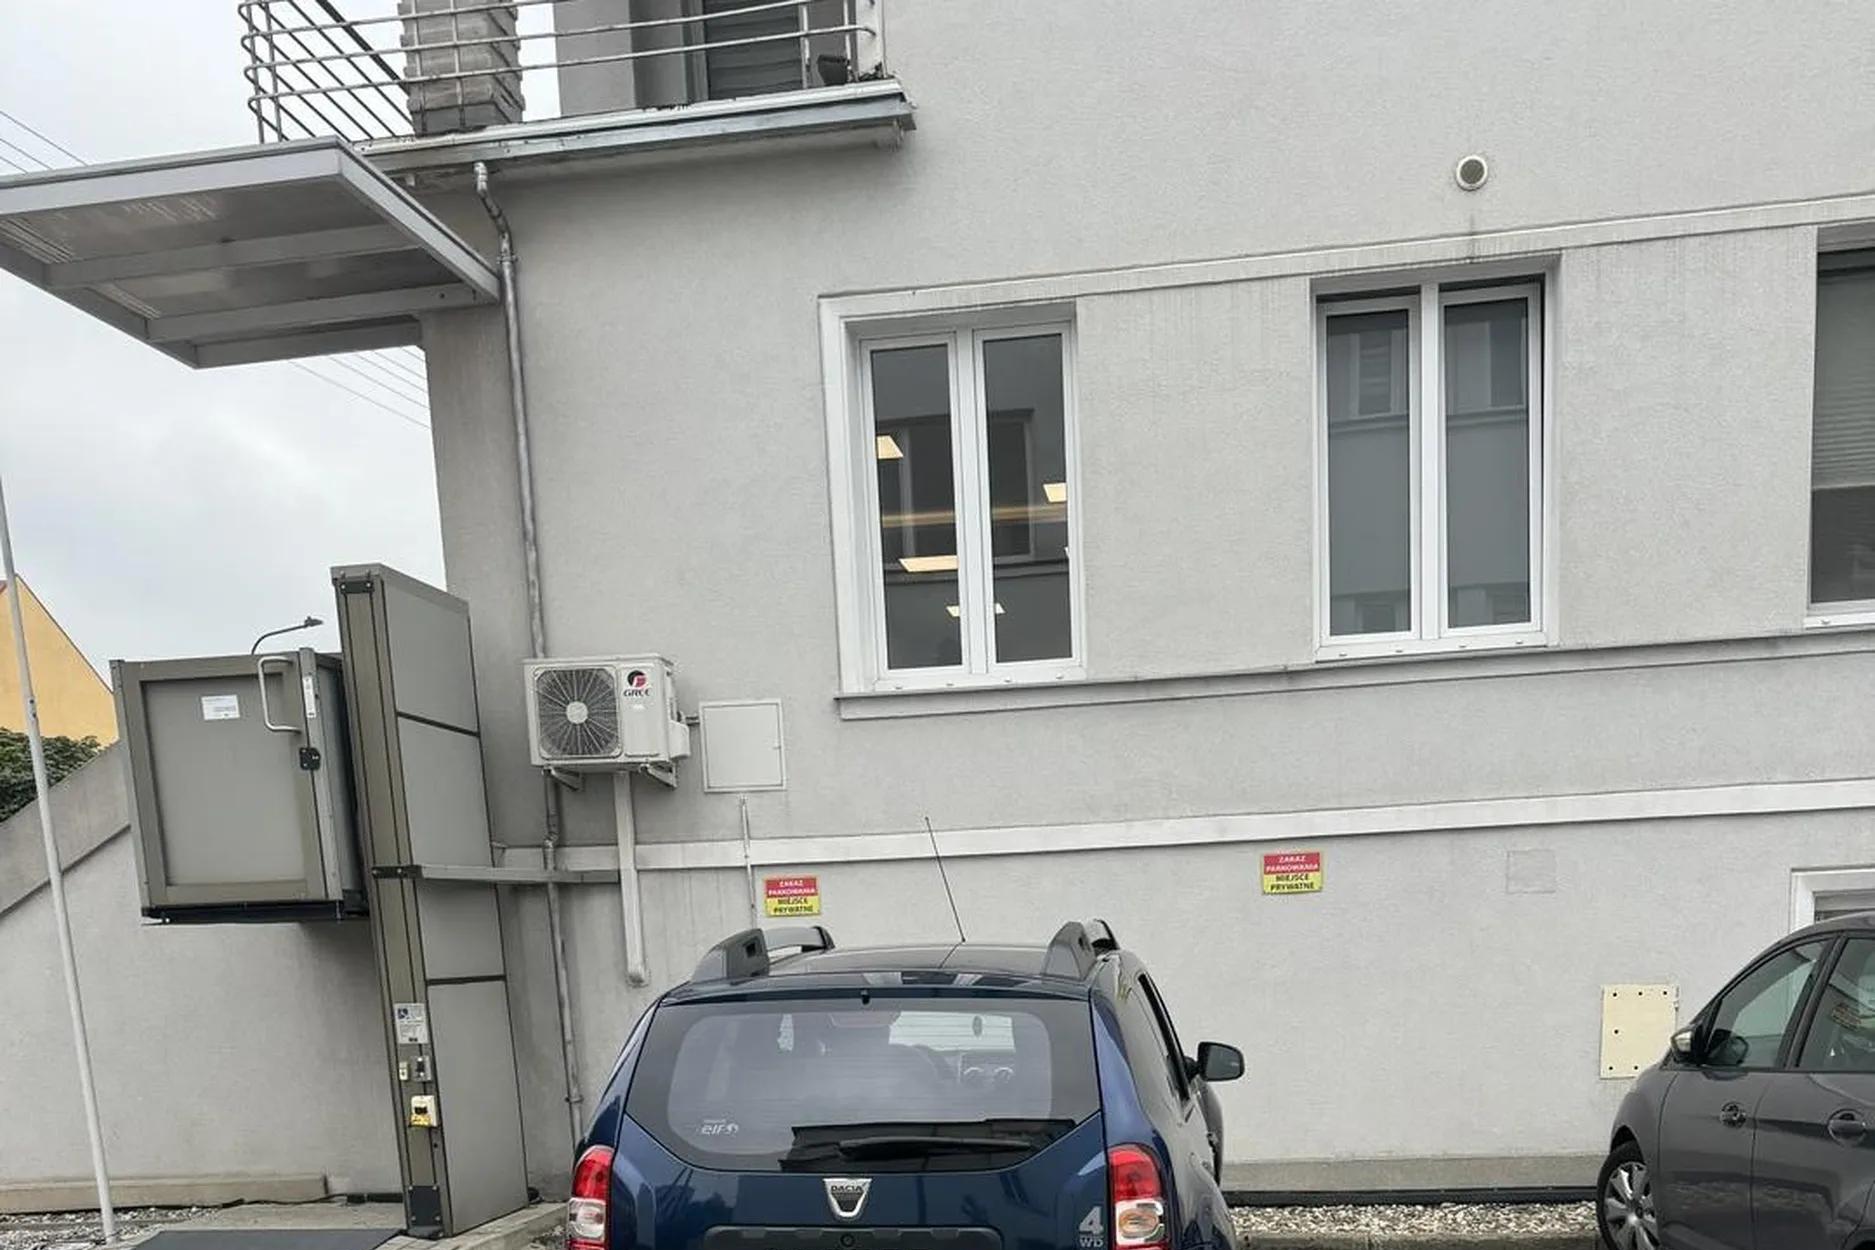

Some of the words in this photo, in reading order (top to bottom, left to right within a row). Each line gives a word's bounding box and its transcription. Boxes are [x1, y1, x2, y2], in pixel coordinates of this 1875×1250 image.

[1278, 854, 1307, 863] ZAKAZ
[1266, 863, 1319, 874] PARKOWANIA
[1276, 873, 1309, 882] MIEJSCE
[779, 880, 804, 888] ZAKAZ
[1271, 882, 1315, 891] PRYWATNE
[768, 888, 816, 896] PARKOWANIA
[777, 897, 808, 905] MIEJSCE
[773, 905, 814, 914] PRYWATNE
[830, 1185, 863, 1193] DACIA
[1079, 1206, 1104, 1235] 4
[1079, 1235, 1104, 1248] WD
